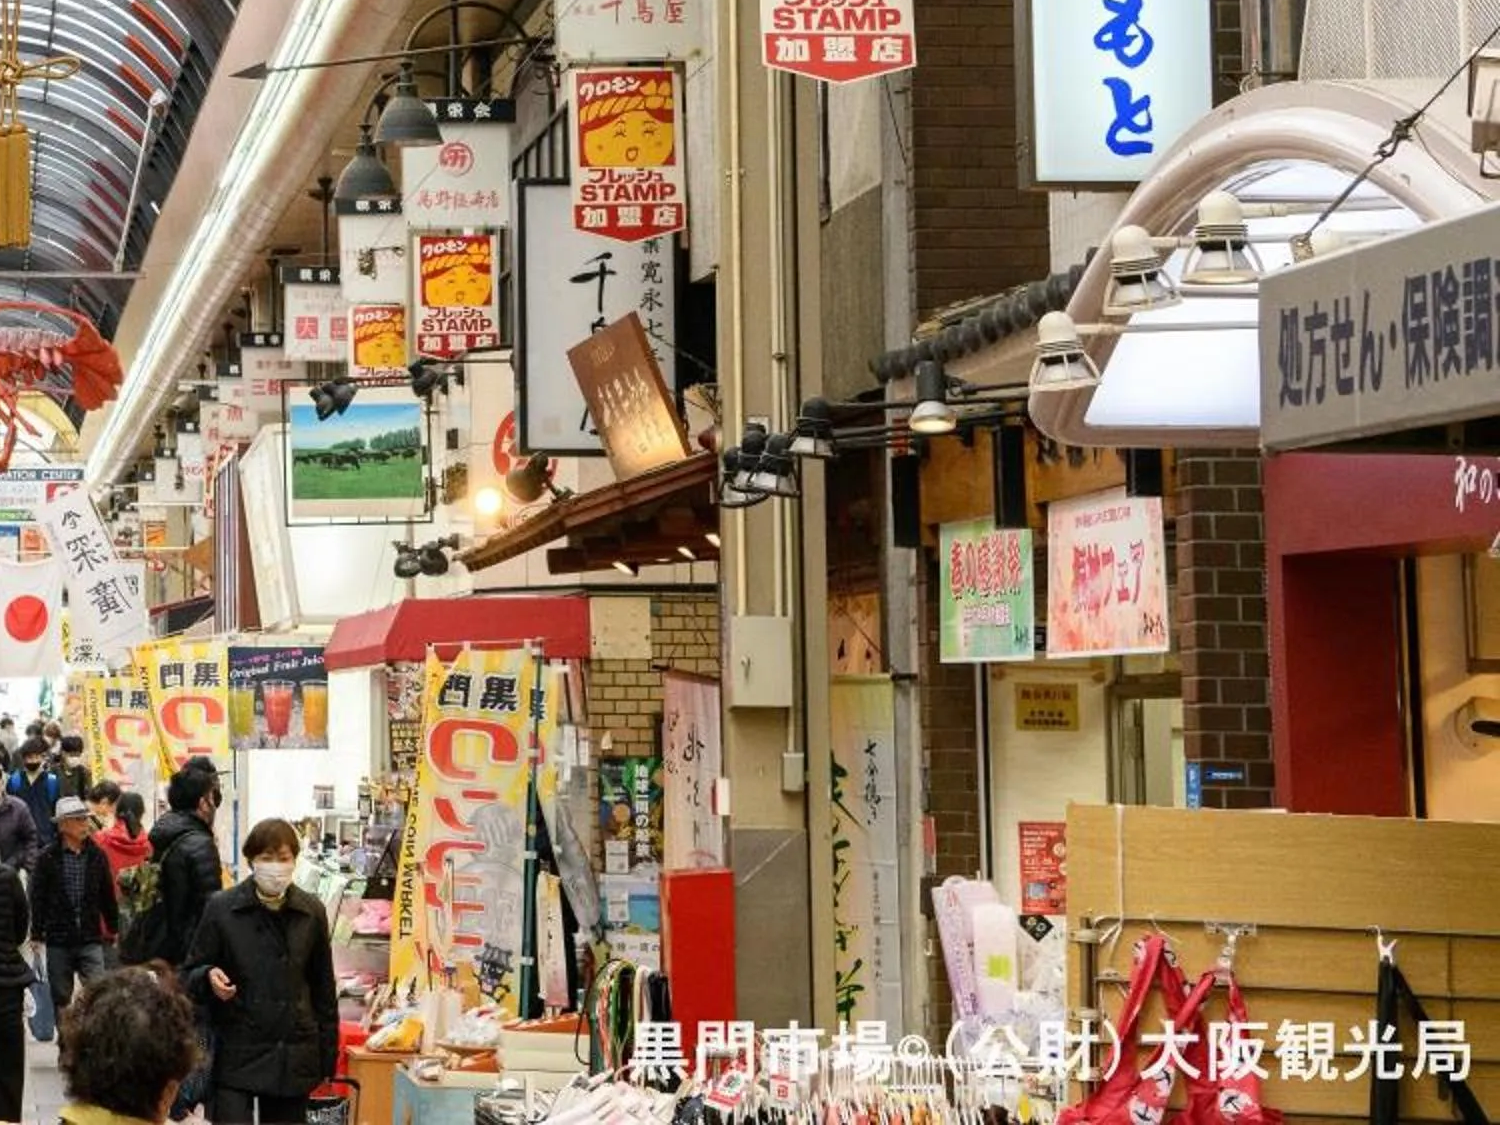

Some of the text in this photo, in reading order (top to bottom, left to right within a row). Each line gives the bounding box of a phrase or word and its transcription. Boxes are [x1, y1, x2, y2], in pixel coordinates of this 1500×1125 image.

[772, 6, 902, 32] STAMP
[773, 35, 905, 62] 加盟店
[579, 78, 641, 103] クロモン
[587, 168, 665, 183] フレッシュ
[579, 182, 678, 203] STAMP
[580, 205, 678, 228] 加盟店
[421, 318, 494, 333] STAMP
[1278, 257, 1500, 410] 処方せん・保険調
[422, 332, 495, 352] 加盟店
